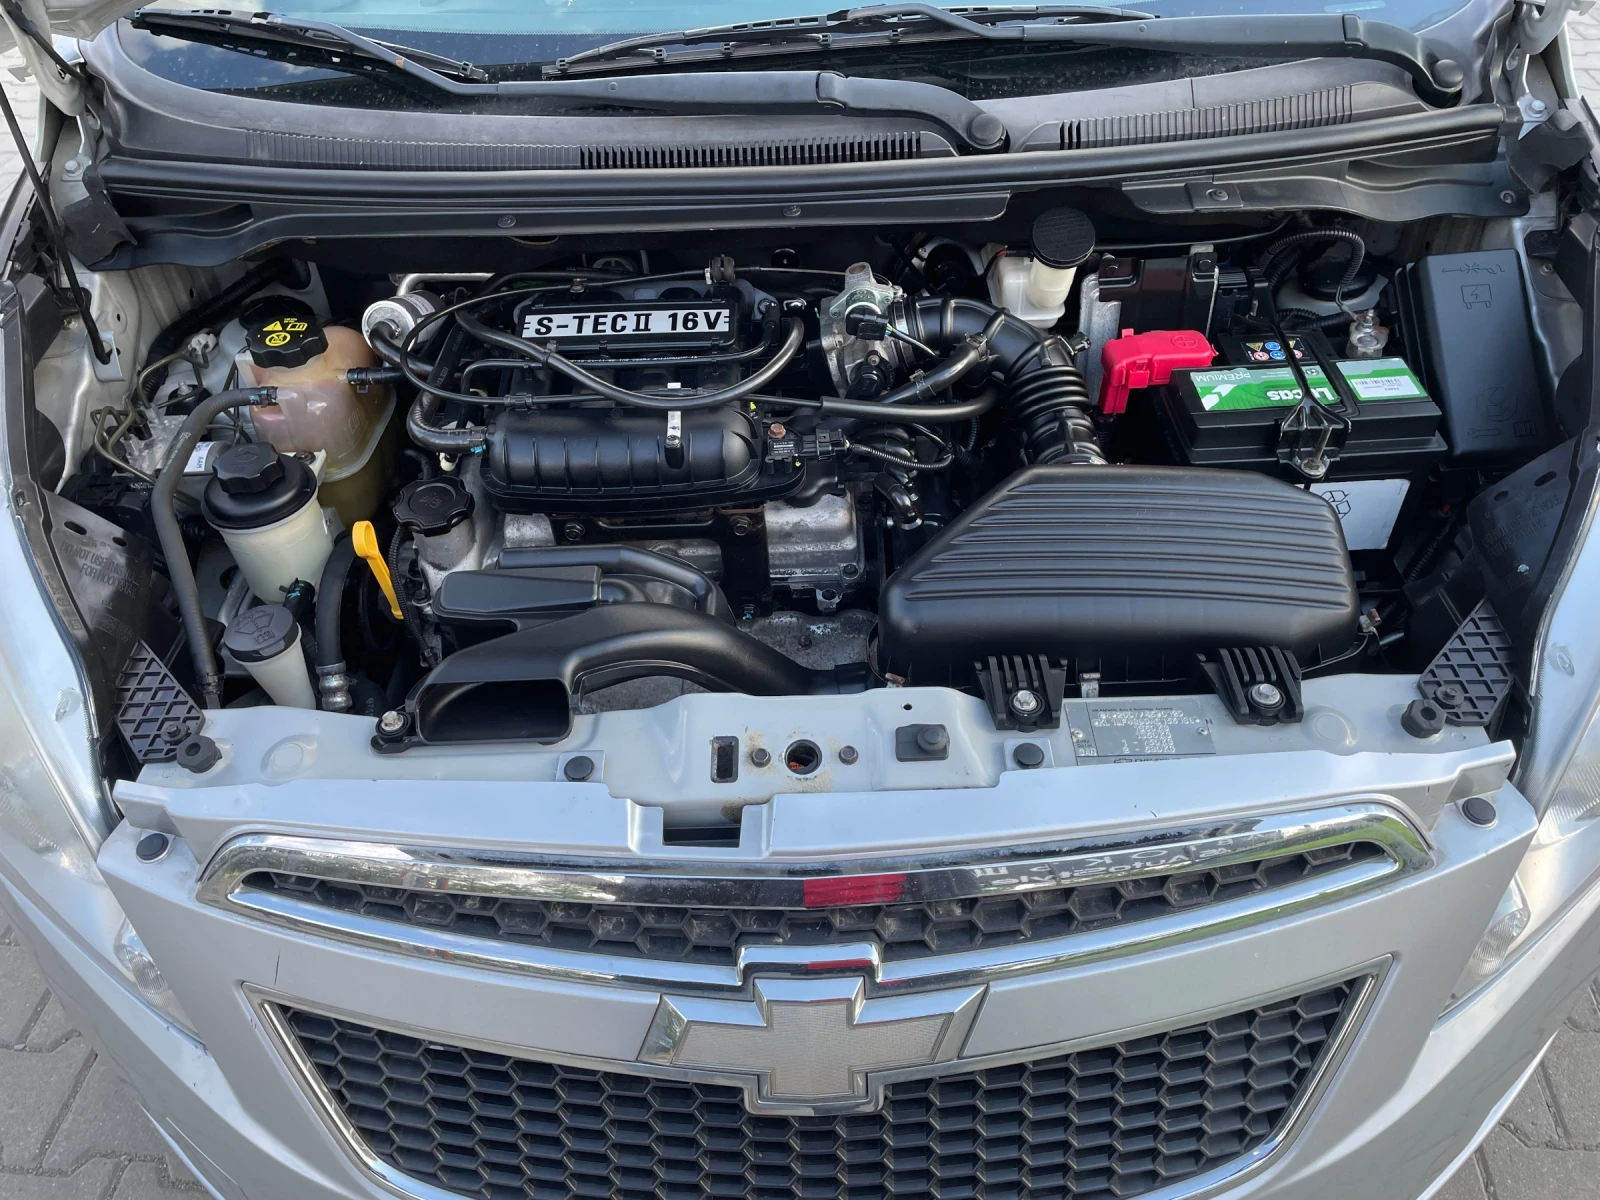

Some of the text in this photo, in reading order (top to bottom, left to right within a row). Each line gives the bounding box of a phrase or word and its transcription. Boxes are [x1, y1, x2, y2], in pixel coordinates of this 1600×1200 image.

[668, 311, 722, 332] 16V
[1195, 371, 1251, 382] PREMIUM
[60, 542, 75, 554] DO
[74, 545, 92, 560] NOT
[91, 552, 106, 568] USE
[106, 558, 124, 575] THIS
[80, 562, 98, 578] FOR
[98, 570, 120, 588] HOOD
